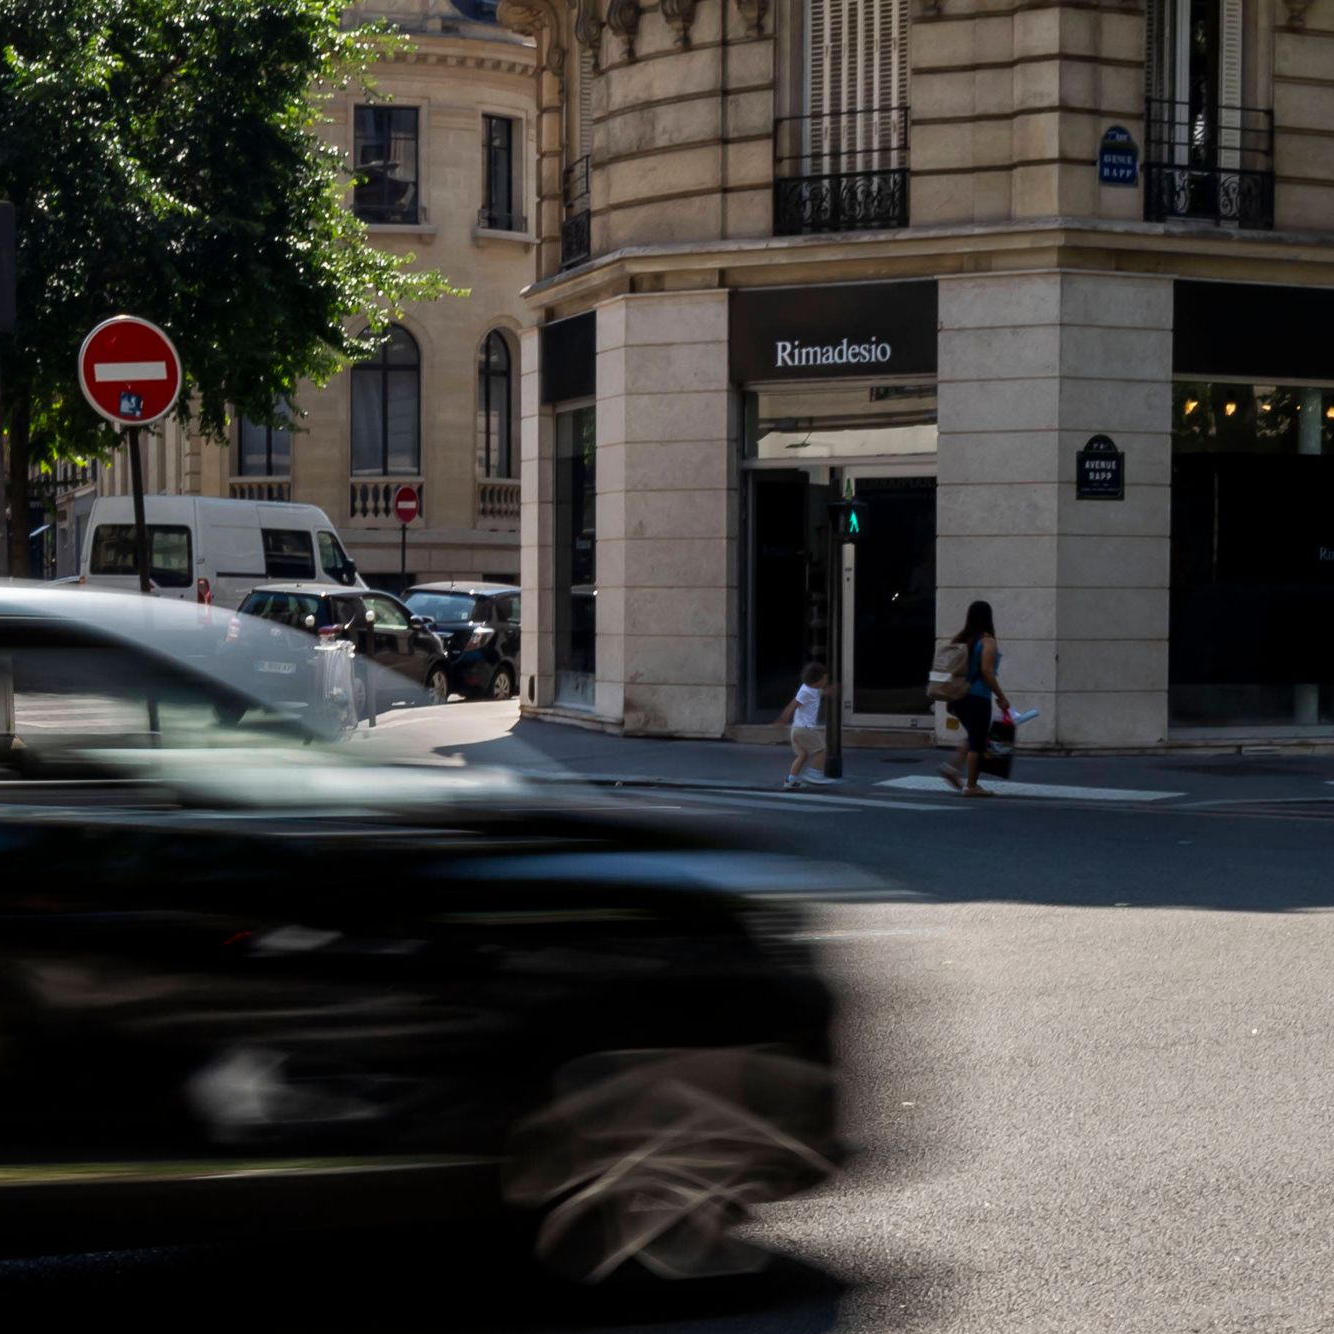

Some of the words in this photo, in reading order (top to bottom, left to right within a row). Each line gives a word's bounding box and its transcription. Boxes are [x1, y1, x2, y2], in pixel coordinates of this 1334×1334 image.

[775, 336, 891, 367] Rimadesio
[1084, 460, 1117, 470] AVENUE
[1088, 471, 1113, 481] RAPP
